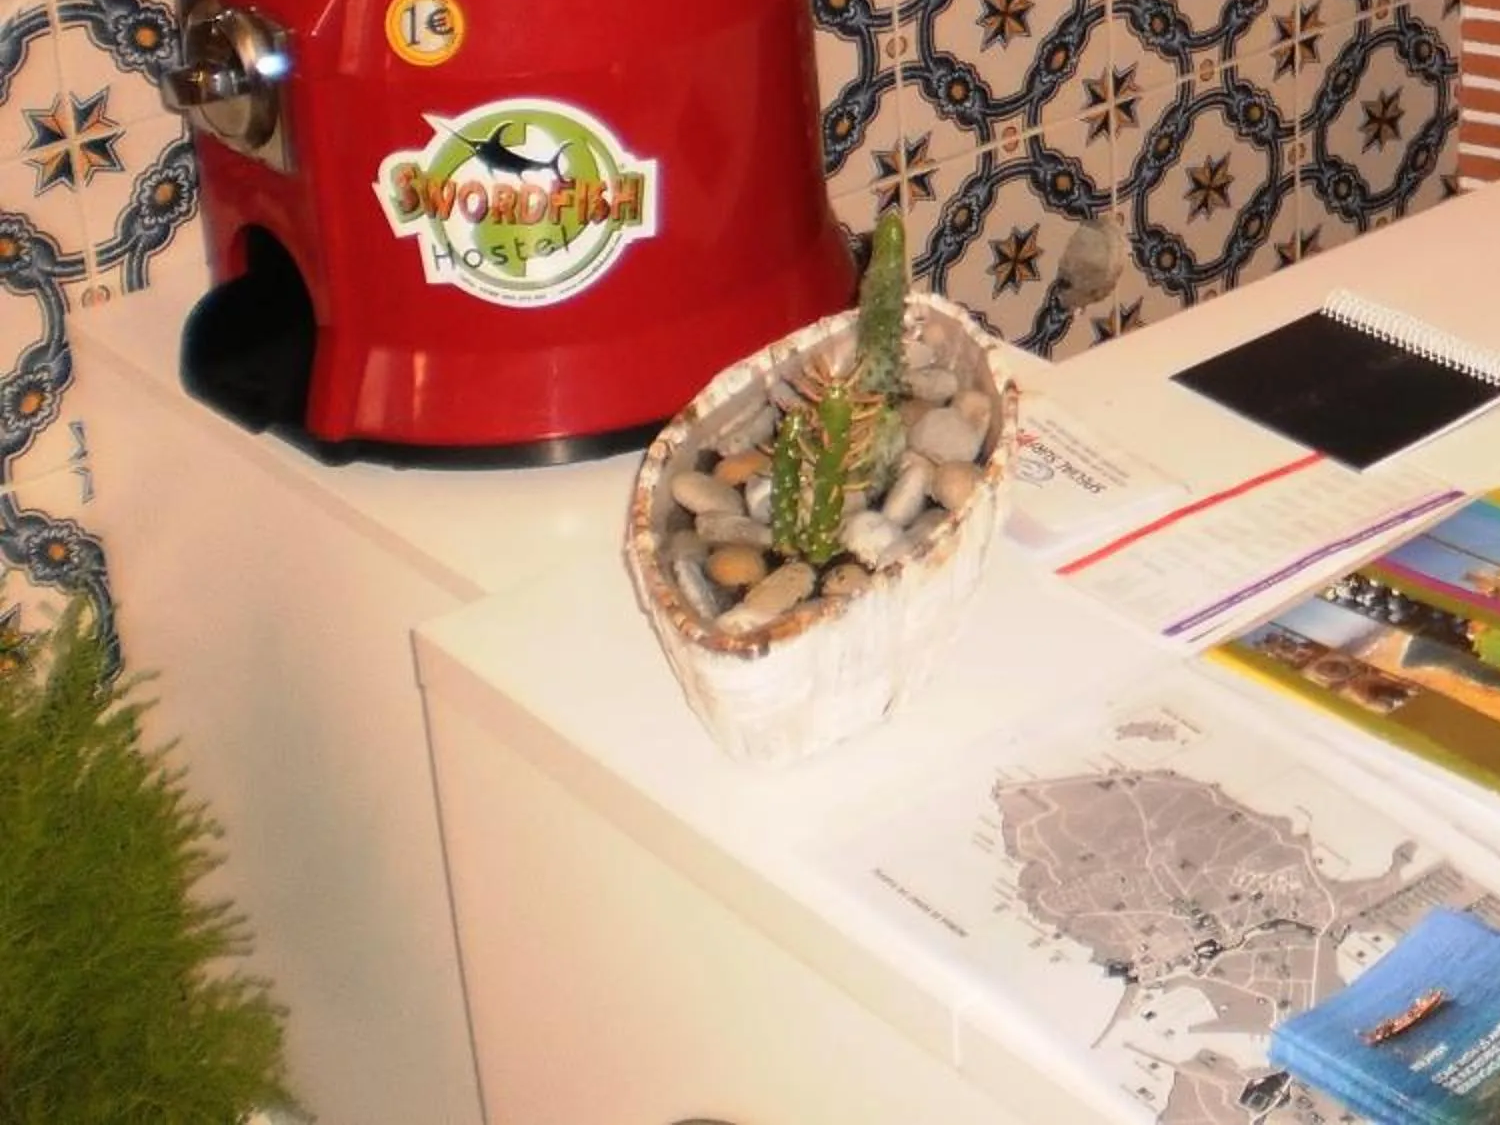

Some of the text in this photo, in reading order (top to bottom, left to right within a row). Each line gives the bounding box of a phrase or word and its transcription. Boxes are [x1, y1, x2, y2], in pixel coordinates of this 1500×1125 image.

[403, 3, 454, 48] 1€
[393, 163, 643, 224] SWORDFISH
[432, 227, 570, 271] Hostel
